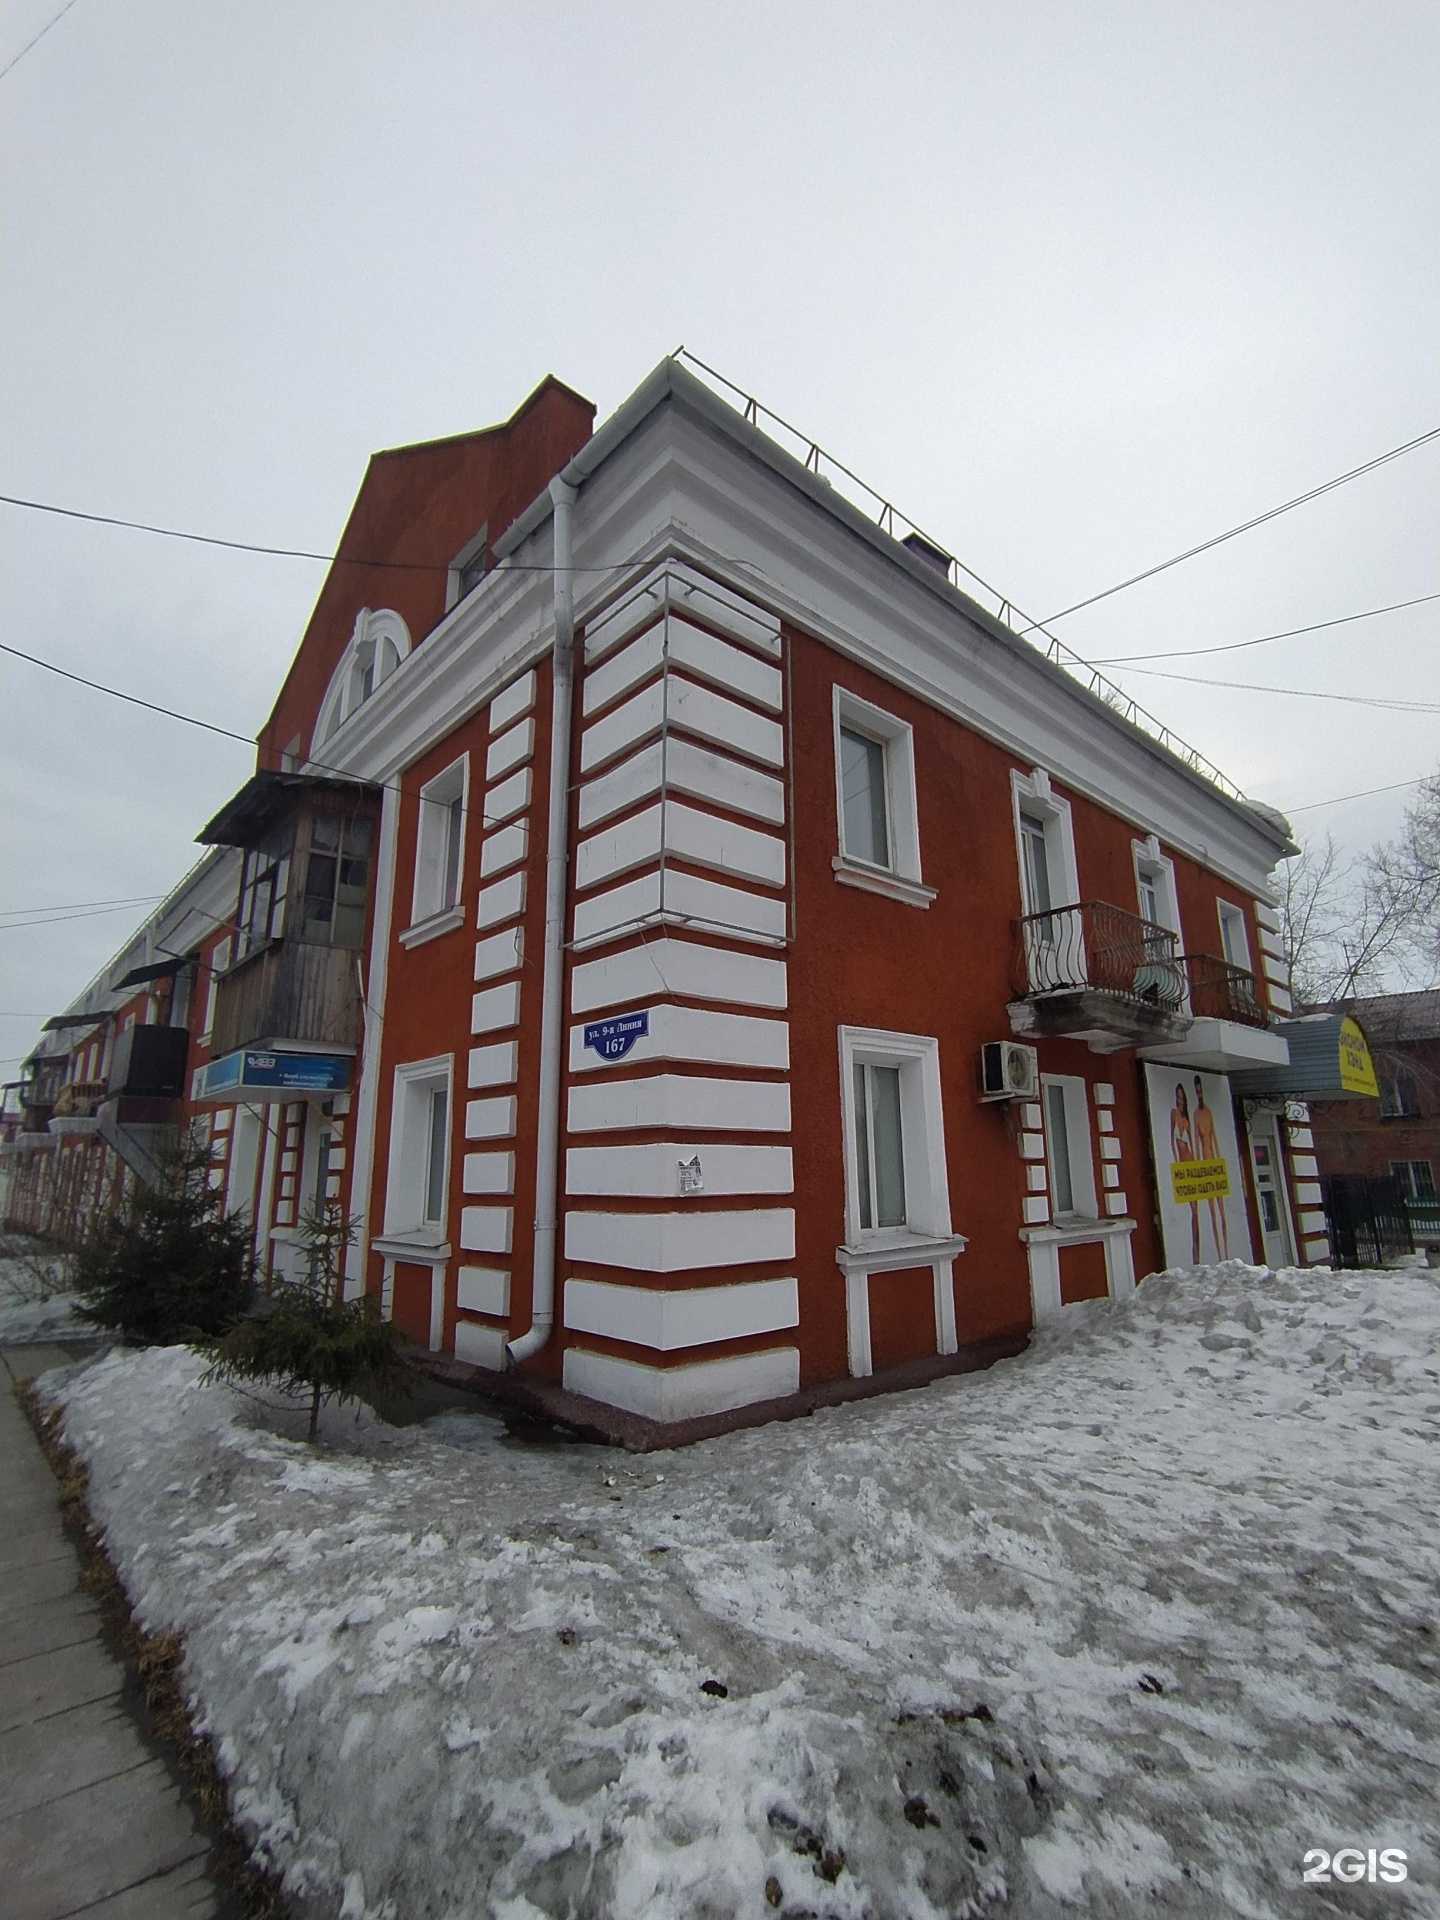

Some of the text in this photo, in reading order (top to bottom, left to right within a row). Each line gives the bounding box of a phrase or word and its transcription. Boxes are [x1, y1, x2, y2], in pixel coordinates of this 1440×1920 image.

[588, 1020, 642, 1041] ул. 9-я Линия
[605, 1038, 625, 1054] 167
